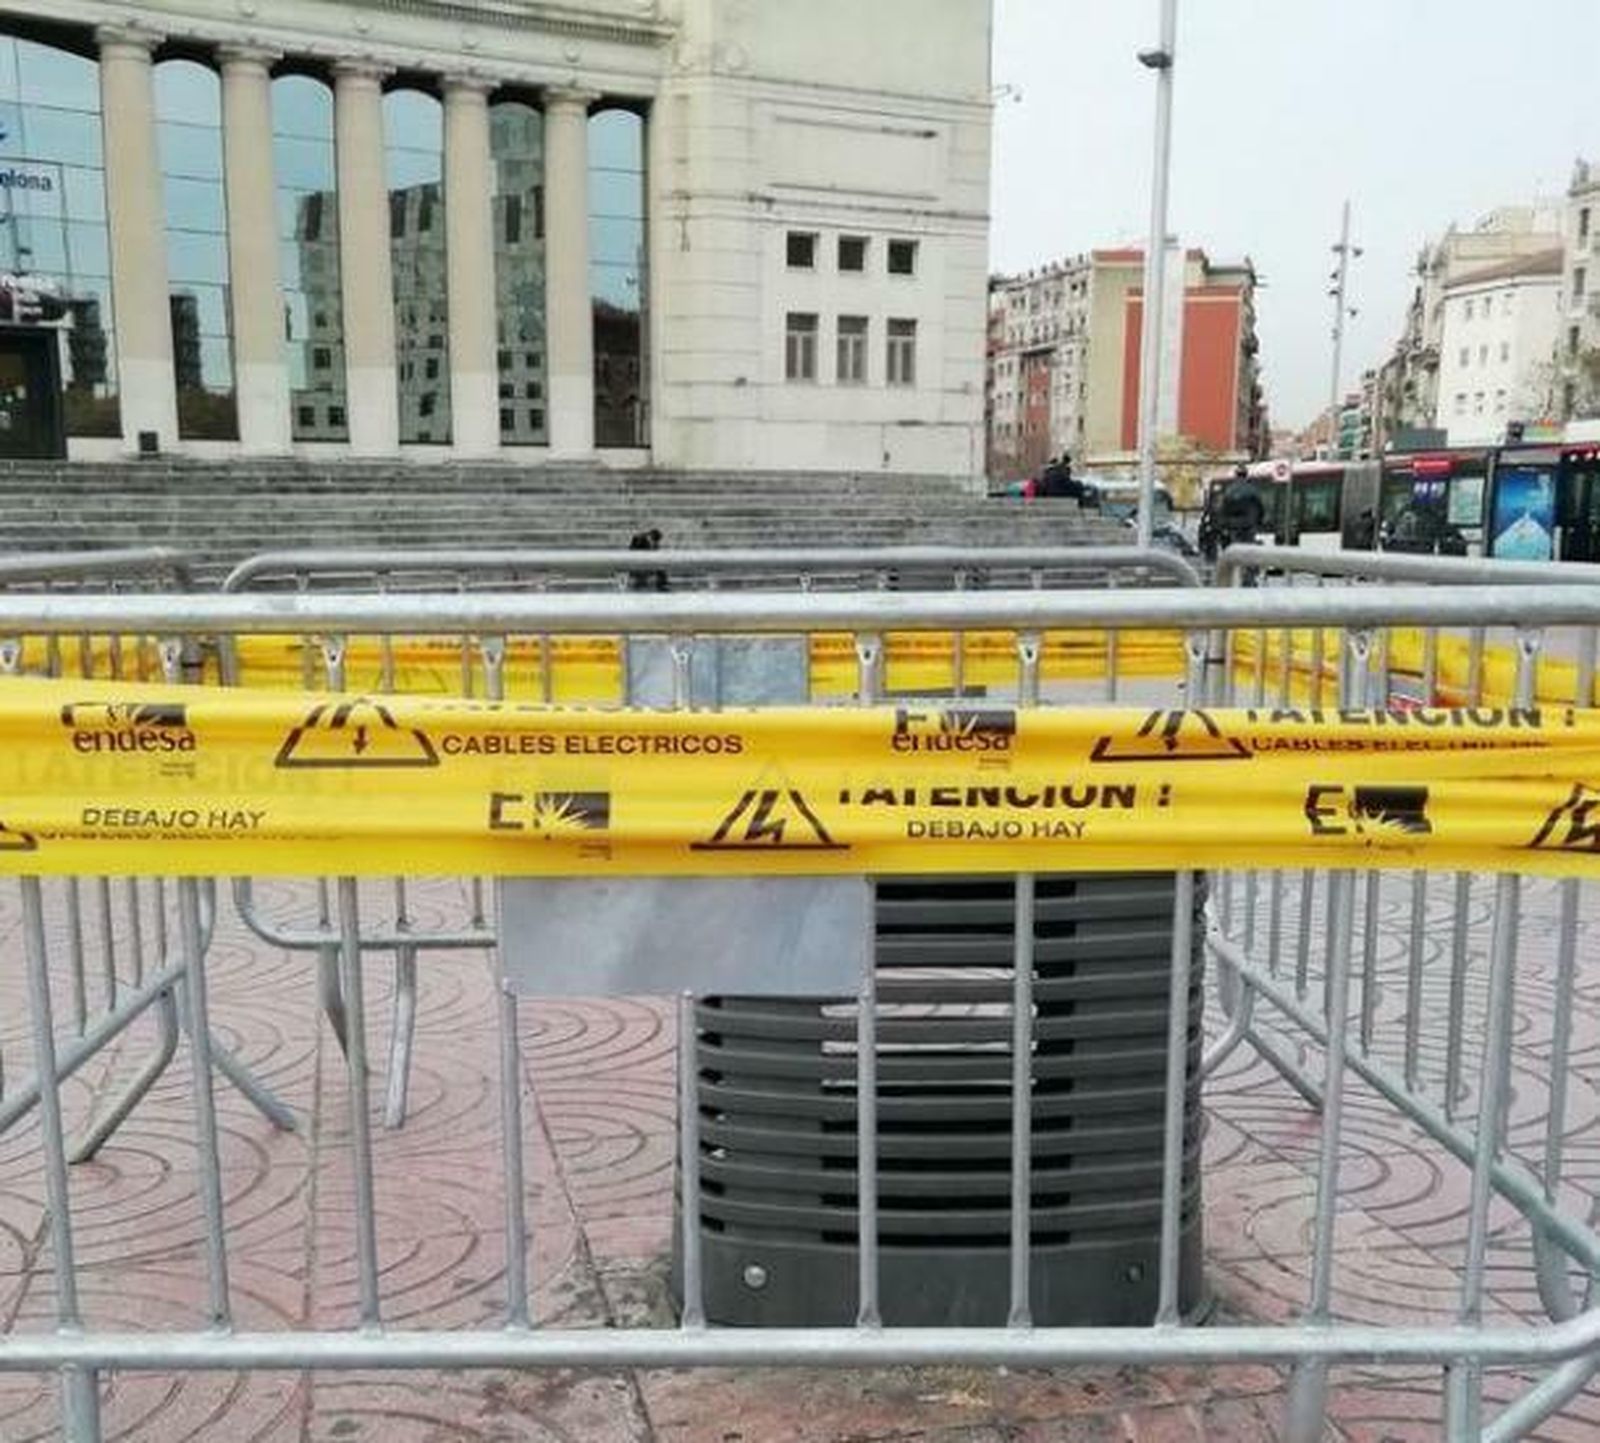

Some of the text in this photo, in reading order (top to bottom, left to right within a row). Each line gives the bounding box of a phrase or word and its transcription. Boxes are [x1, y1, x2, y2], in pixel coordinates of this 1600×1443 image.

[73, 724, 197, 753] endesa
[442, 735, 744, 756] CABLES ELECTRICOS
[82, 808, 267, 830] DEBAJO HAY
[906, 820, 1088, 840] DEBAJO HAY
